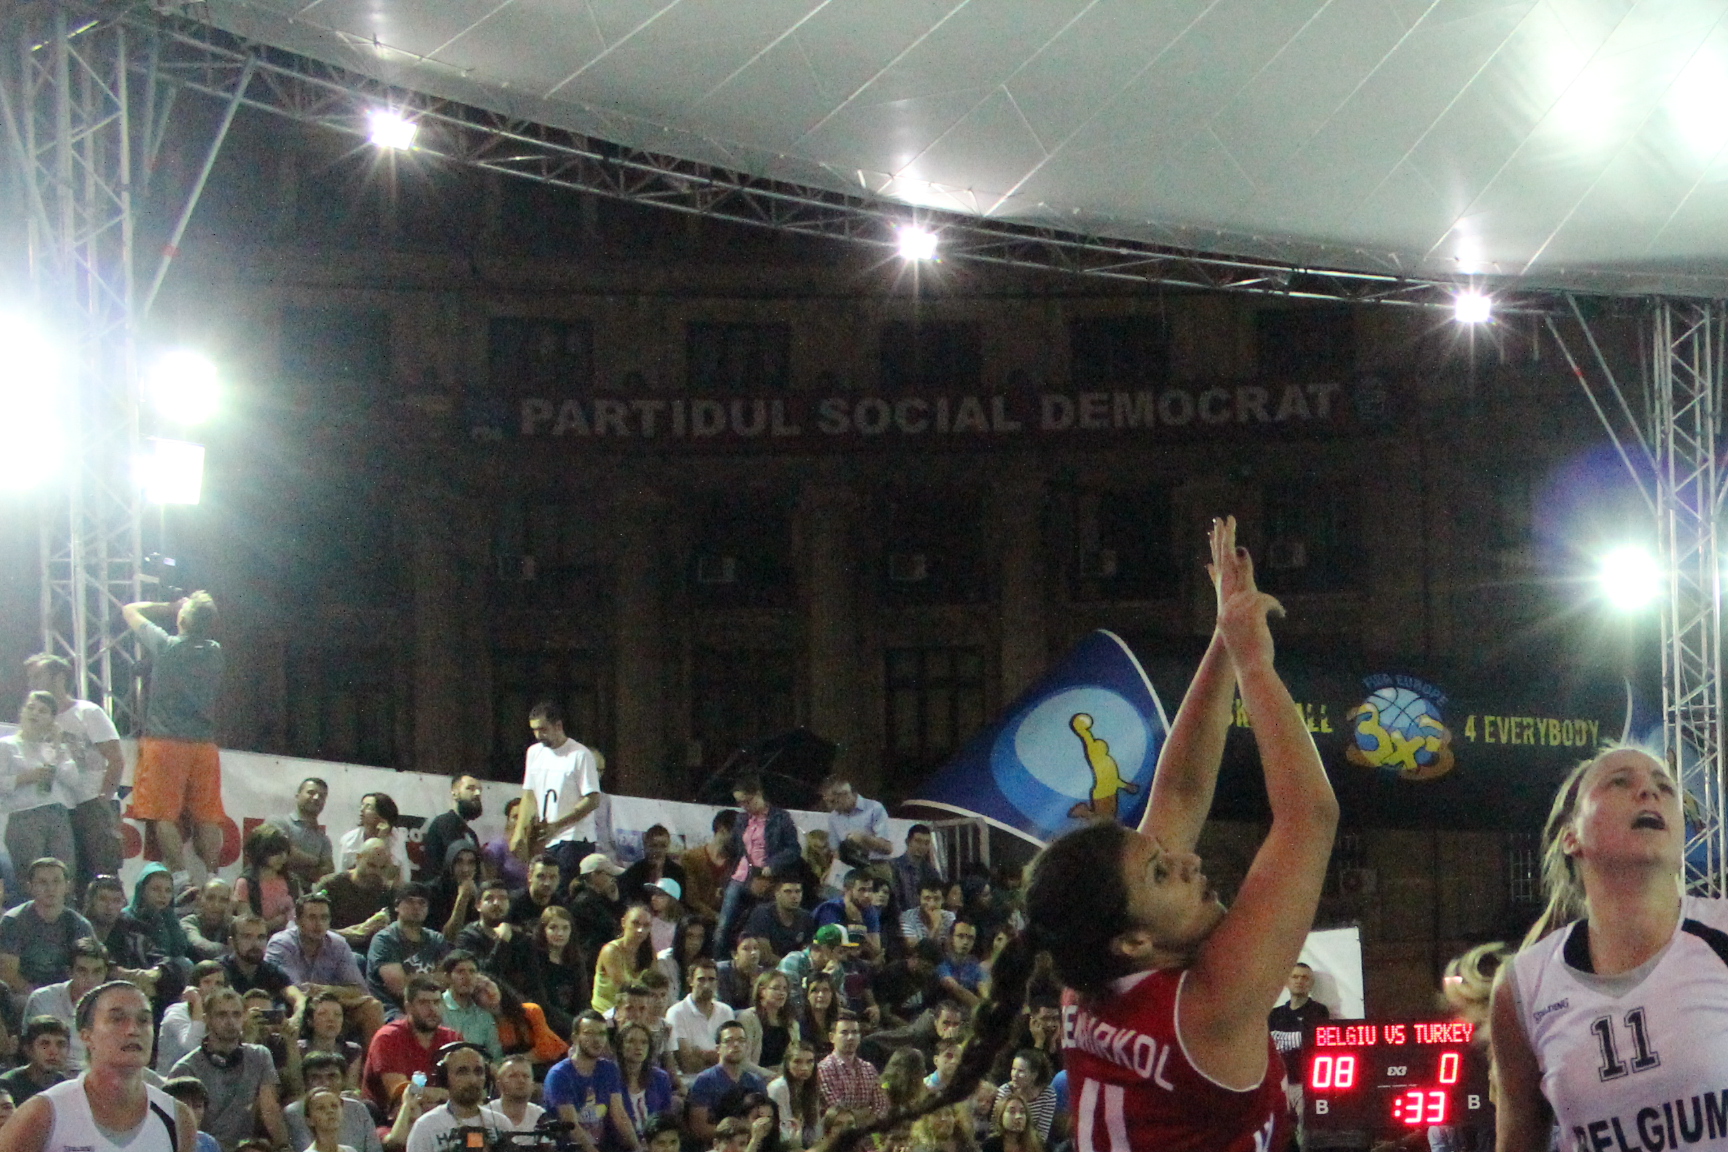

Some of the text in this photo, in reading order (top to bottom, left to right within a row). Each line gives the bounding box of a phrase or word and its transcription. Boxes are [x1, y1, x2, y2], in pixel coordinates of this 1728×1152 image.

[522, 382, 1340, 437] PARTIDUL SOCIAL DEMOCRAT
[1465, 714, 1601, 748] 4 EVERYBODY
[1316, 1022, 1475, 1046] BELGIU VS TURKEY
[1590, 1006, 1661, 1082] 11
[1312, 1056, 1355, 1088] 08
[1439, 1052, 1459, 1084] 0
[1316, 1100, 1329, 1115] B
[1468, 1095, 1481, 1110] B
